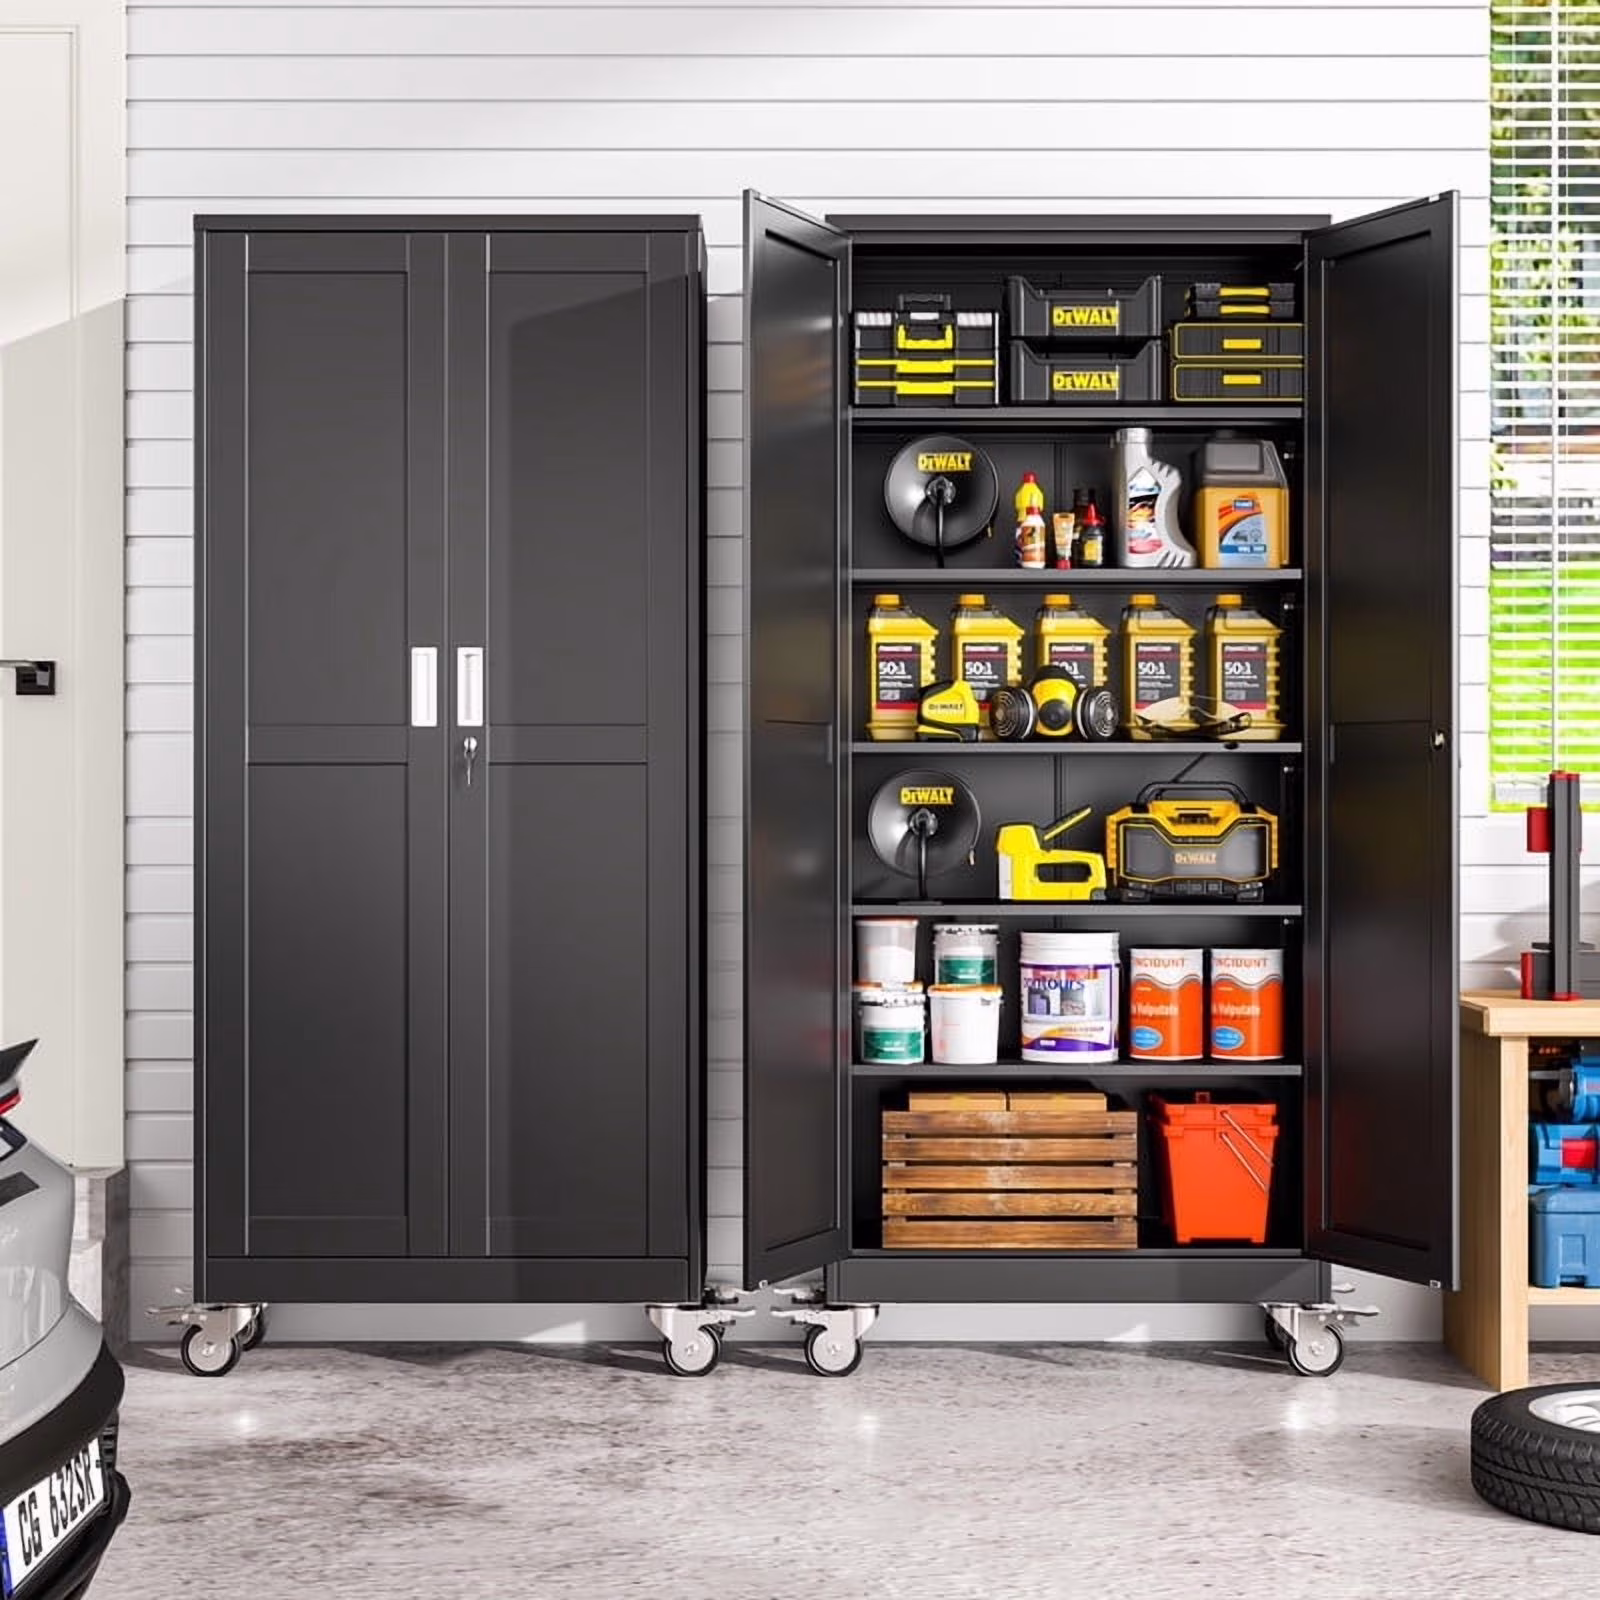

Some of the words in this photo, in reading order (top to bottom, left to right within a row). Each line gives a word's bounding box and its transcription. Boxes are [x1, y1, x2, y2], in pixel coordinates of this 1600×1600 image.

[1053, 306, 1119, 326] DEWALT
[1053, 371, 1119, 391] DEWALT
[918, 452, 972, 471] DEWALT
[901, 787, 954, 804] DEWALT
[18, 1491, 43, 1567] CG
